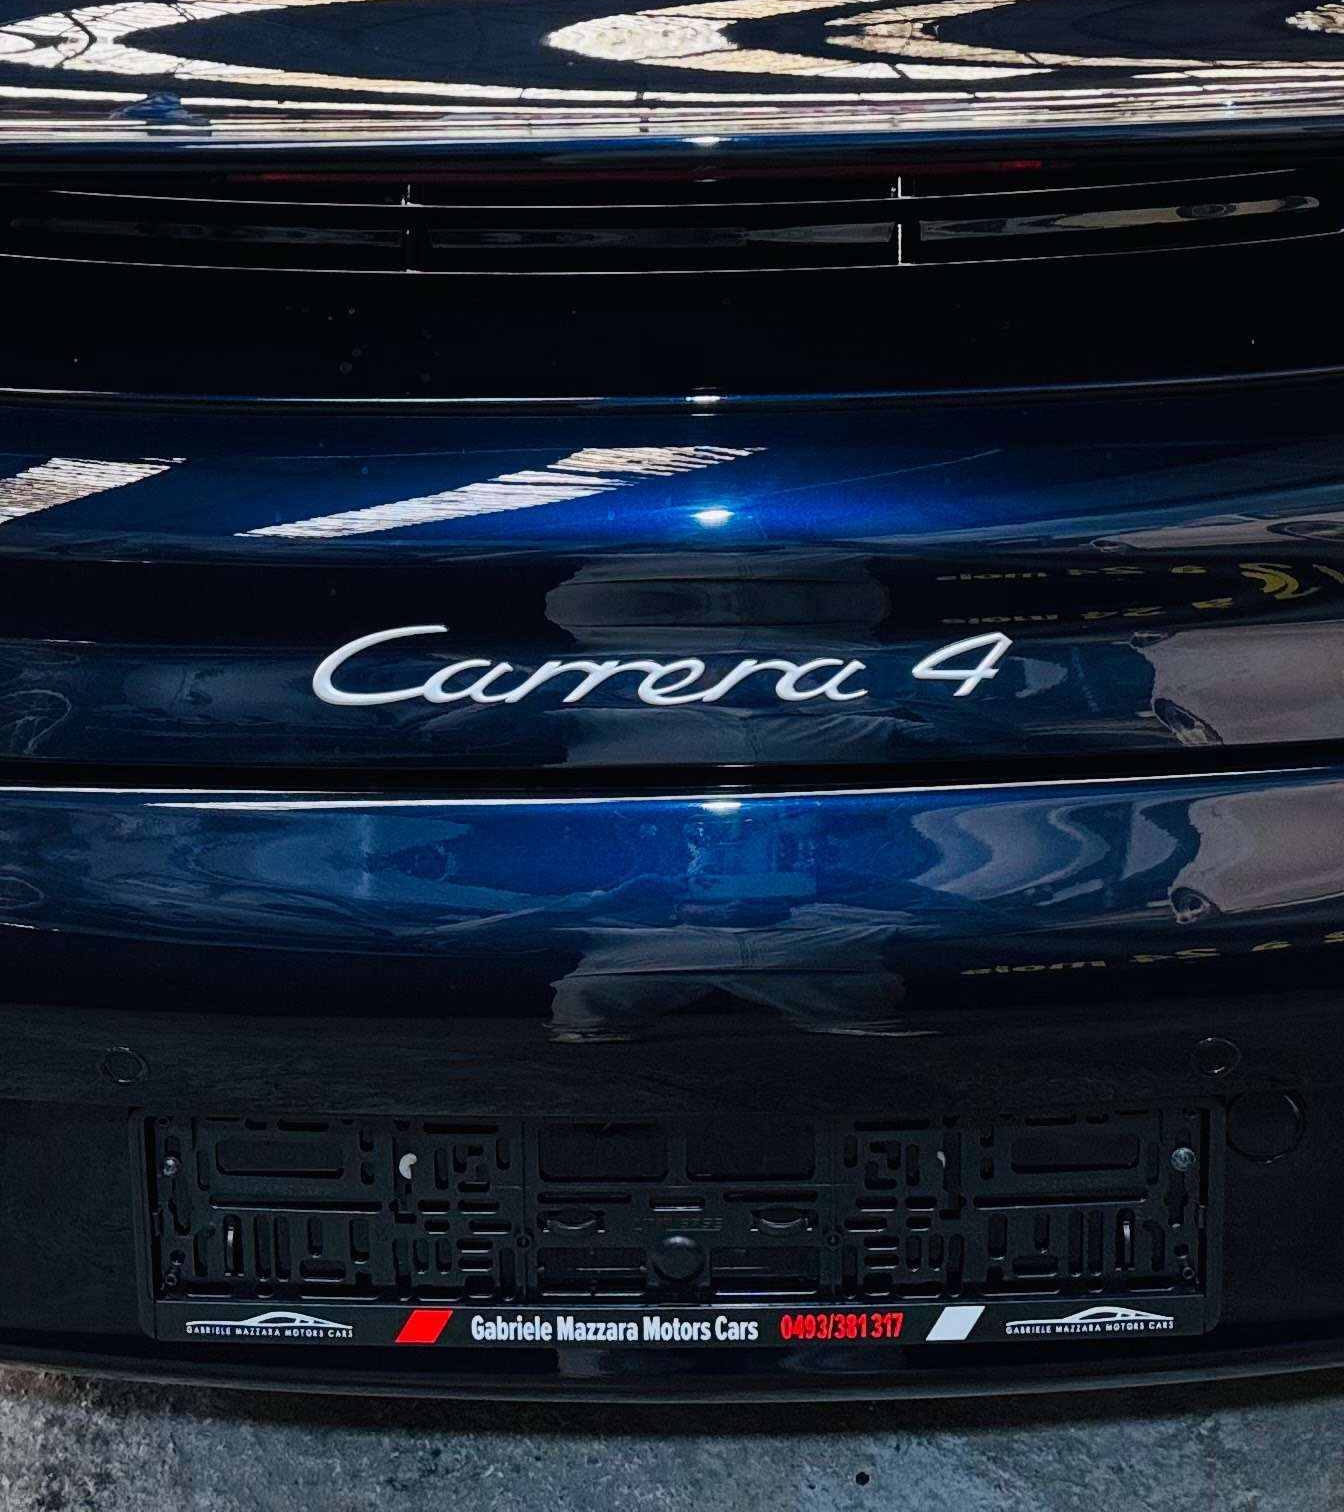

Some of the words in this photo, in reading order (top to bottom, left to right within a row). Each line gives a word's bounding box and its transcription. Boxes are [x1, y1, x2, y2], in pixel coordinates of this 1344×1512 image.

[312, 624, 868, 706] Carrera
[912, 631, 1014, 698] 4
[186, 1325, 231, 1336] GABRIELE
[235, 1326, 281, 1337] MAZZARA
[285, 1327, 325, 1338] MOTORS
[327, 1327, 354, 1339] CARS
[471, 1314, 552, 1342] Gabriele
[557, 1315, 637, 1342] Mazzara
[642, 1315, 711, 1342] Motors
[715, 1314, 759, 1342] Cars
[870, 1312, 904, 1338] 317
[1005, 1324, 1052, 1335] GABRIELE
[1055, 1322, 1102, 1334] MAZZARA
[1105, 1321, 1146, 1333] MOTORS
[1149, 1319, 1175, 1332] CARS
